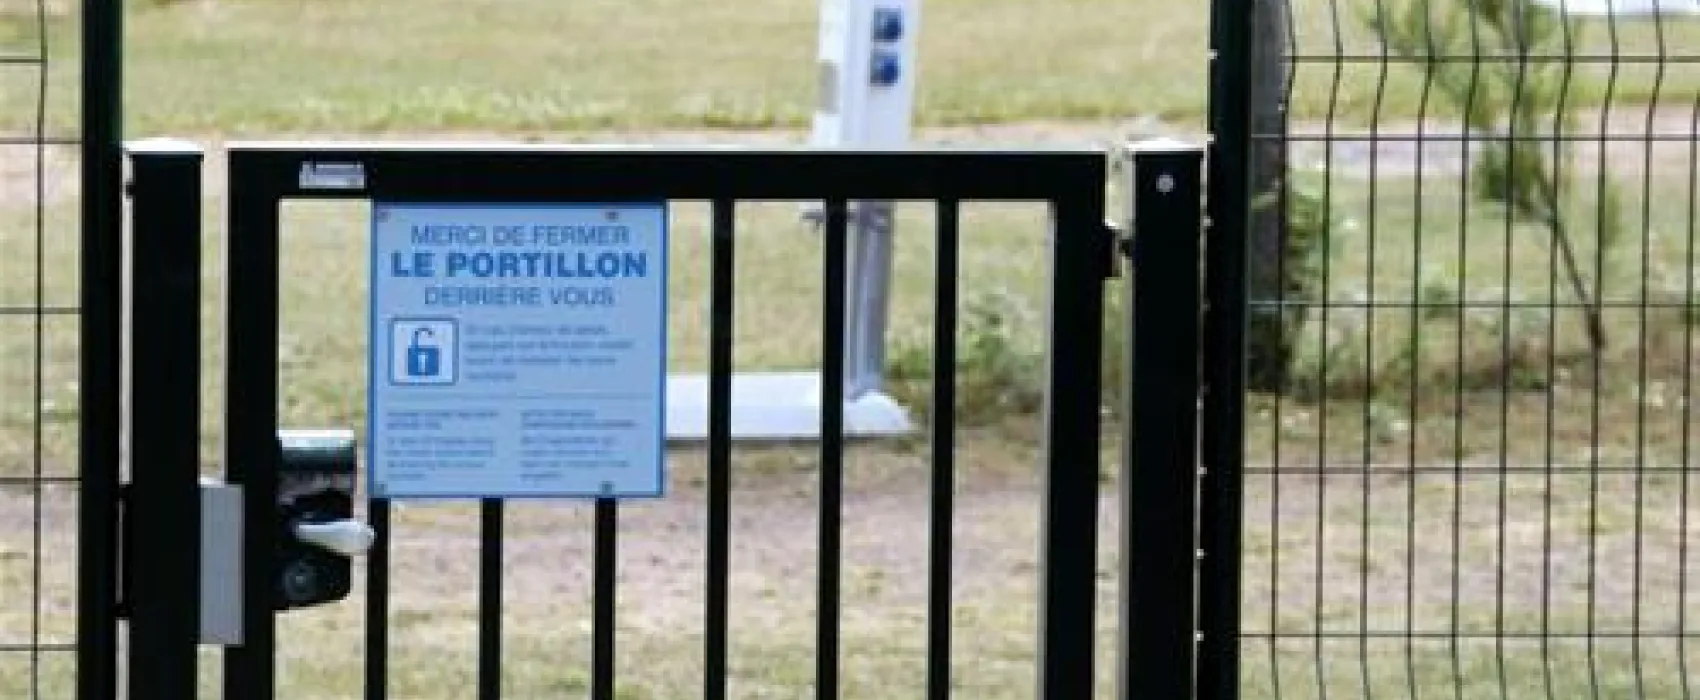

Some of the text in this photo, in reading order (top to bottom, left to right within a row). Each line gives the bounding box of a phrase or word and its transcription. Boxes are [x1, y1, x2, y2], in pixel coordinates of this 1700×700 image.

[411, 226, 629, 246] MERCI DE FERMER
[390, 252, 647, 278] LE PORTILLON
[550, 287, 614, 305] VOUS
